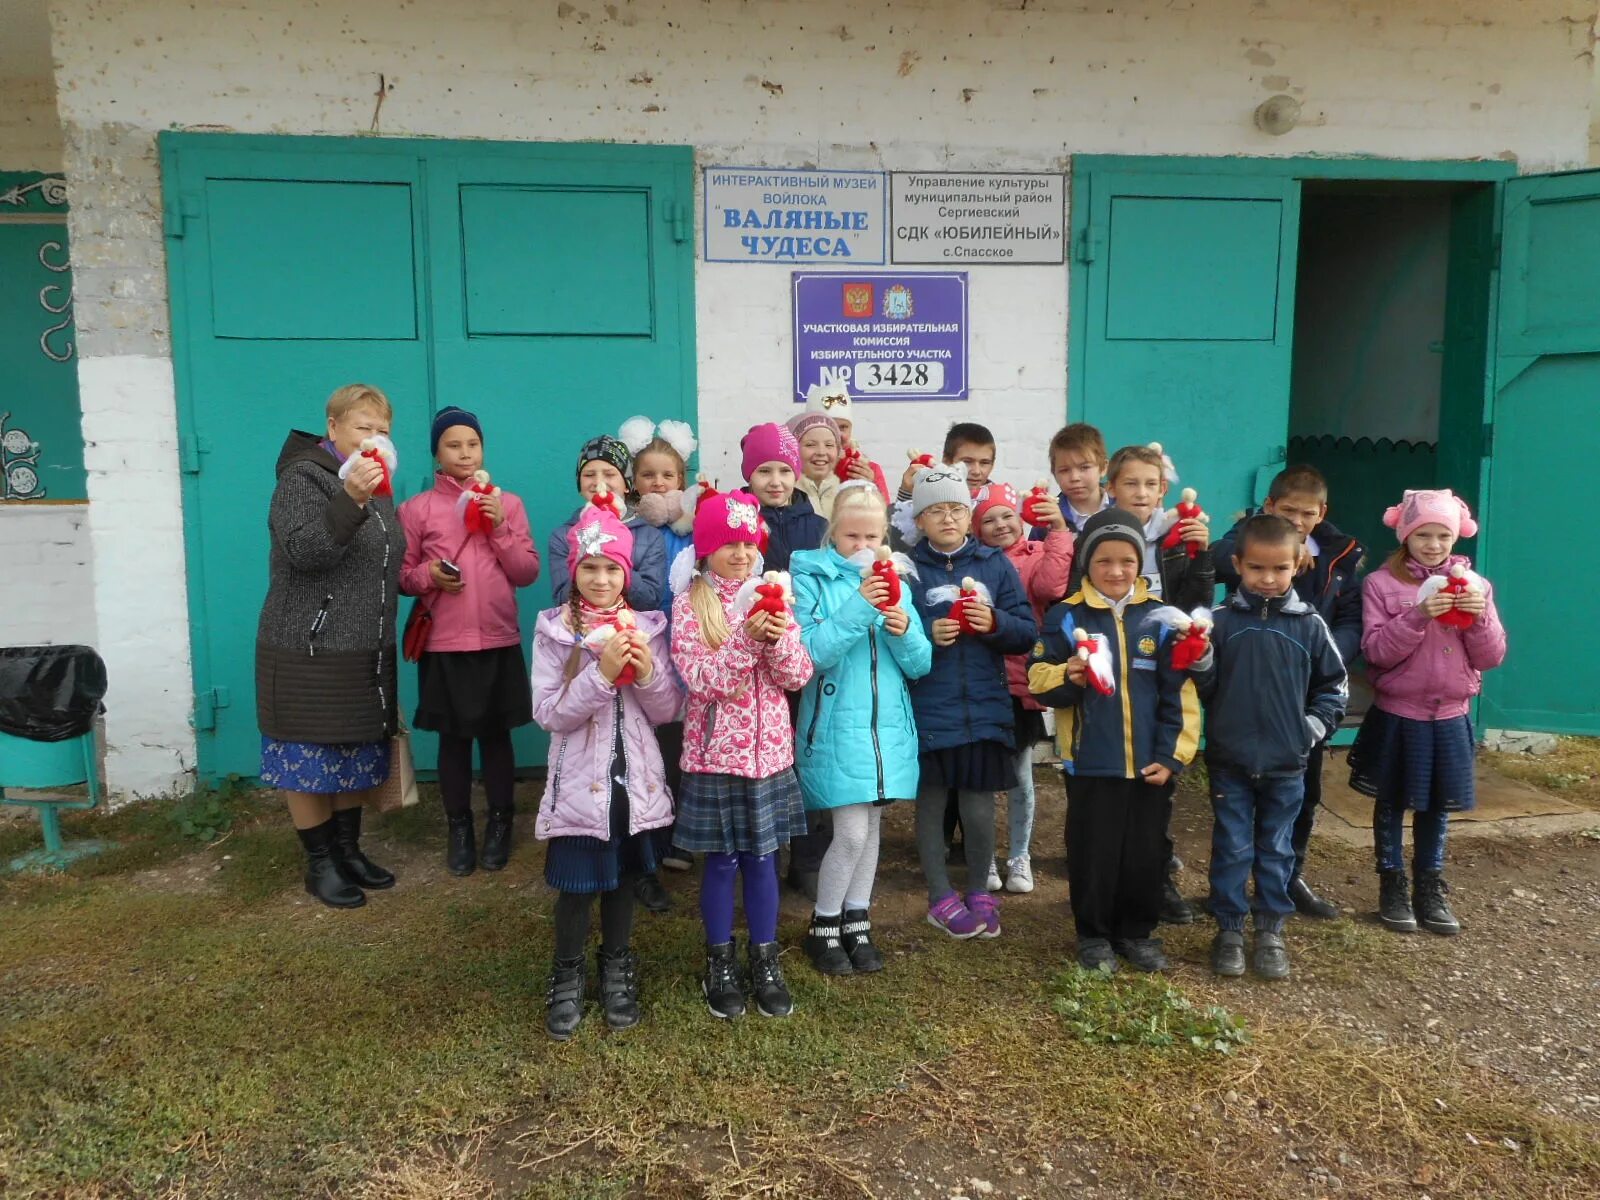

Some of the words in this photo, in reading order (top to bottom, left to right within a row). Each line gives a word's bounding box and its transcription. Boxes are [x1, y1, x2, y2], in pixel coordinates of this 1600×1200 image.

[712, 175, 829, 189] ИНТЕРАКТИВНЫЙ
[833, 176, 877, 189] МУЗЕЙ
[908, 175, 985, 188] Управление
[989, 177, 1049, 189] культуры
[763, 192, 827, 206] ВОЙЛОКА
[904, 191, 1011, 205] муниципальный
[1014, 192, 1052, 205] район
[938, 206, 1020, 220] Сергиевский
[897, 226, 929, 242] СДК
[934, 223, 1060, 240] «ЮБИЛЕЙНЫЙ»
[943, 246, 1014, 257] с.Спасское
[803, 323, 871, 333] УЧАСТКОВАЯ
[872, 323, 959, 333] ИЗБИРАТЕЛЬНАЯ
[853, 336, 910, 346] КОМИССИЯ
[810, 350, 905, 360] ИЗБИРАТЕЛЬНОГО
[906, 349, 952, 359] УЧАСТКА
[867, 363, 929, 387] 3428
